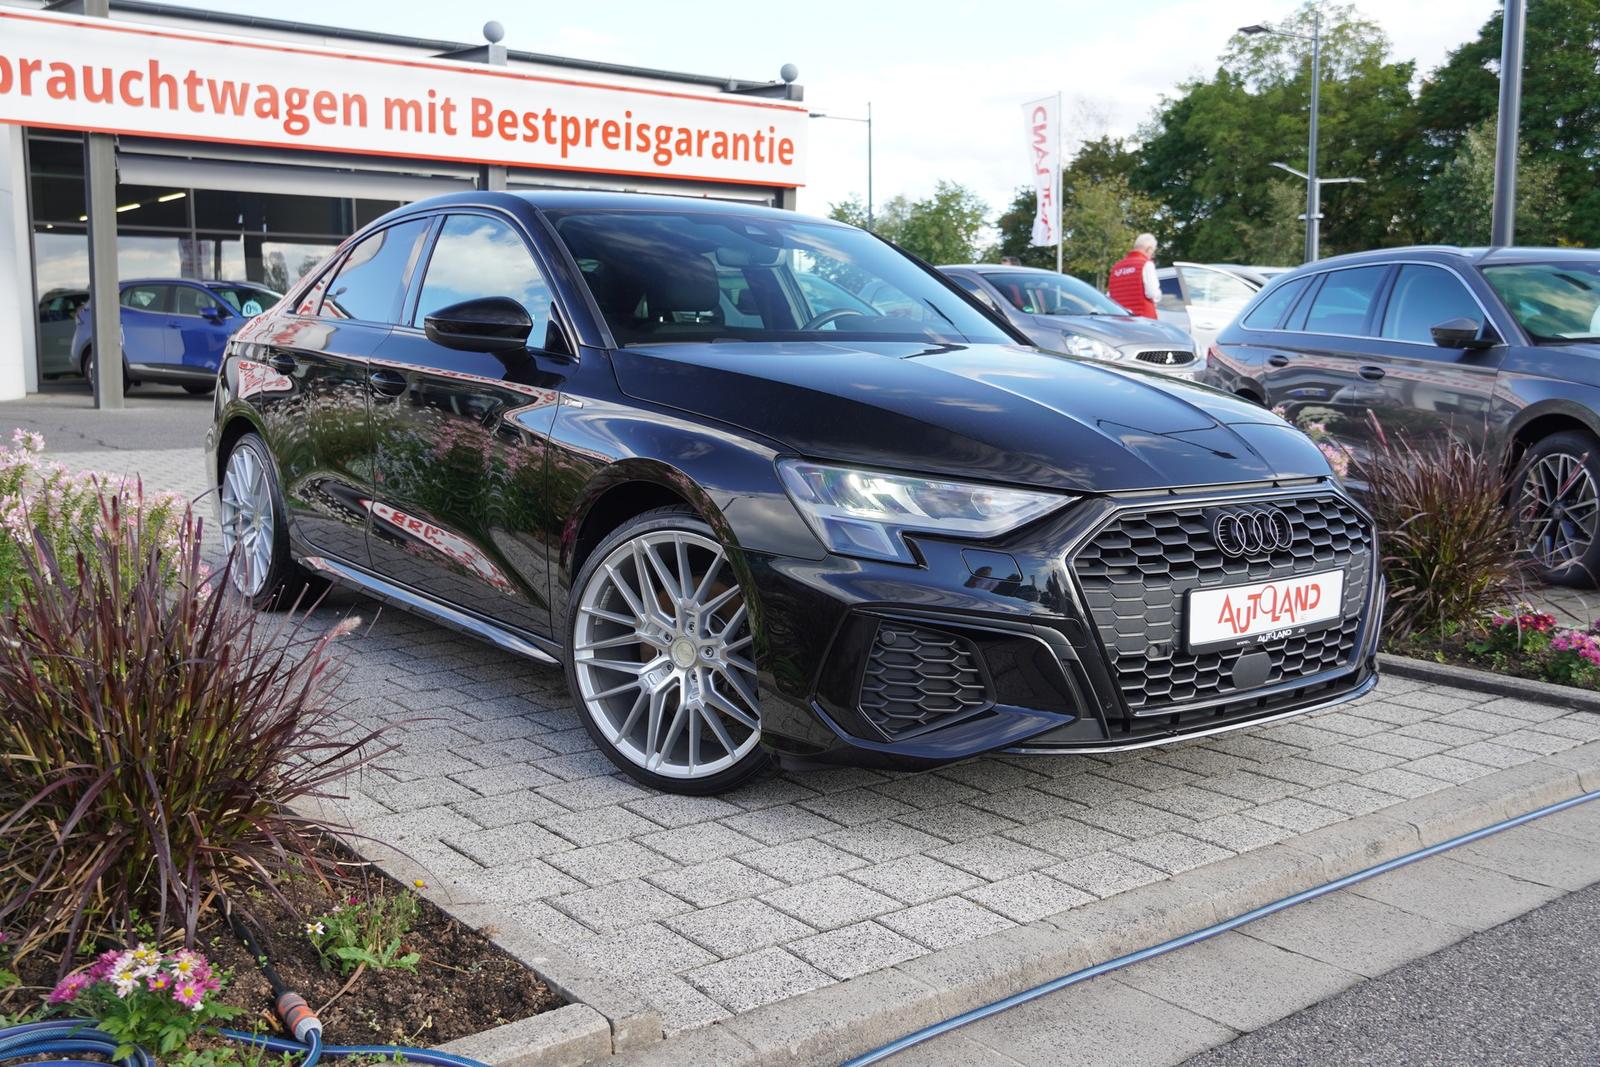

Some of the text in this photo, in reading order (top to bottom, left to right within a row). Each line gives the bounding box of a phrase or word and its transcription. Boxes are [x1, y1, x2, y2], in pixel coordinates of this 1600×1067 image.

[384, 89, 457, 136] mit
[471, 97, 795, 166] Bestpreisgarantie
[246, 303, 259, 315] 0%
